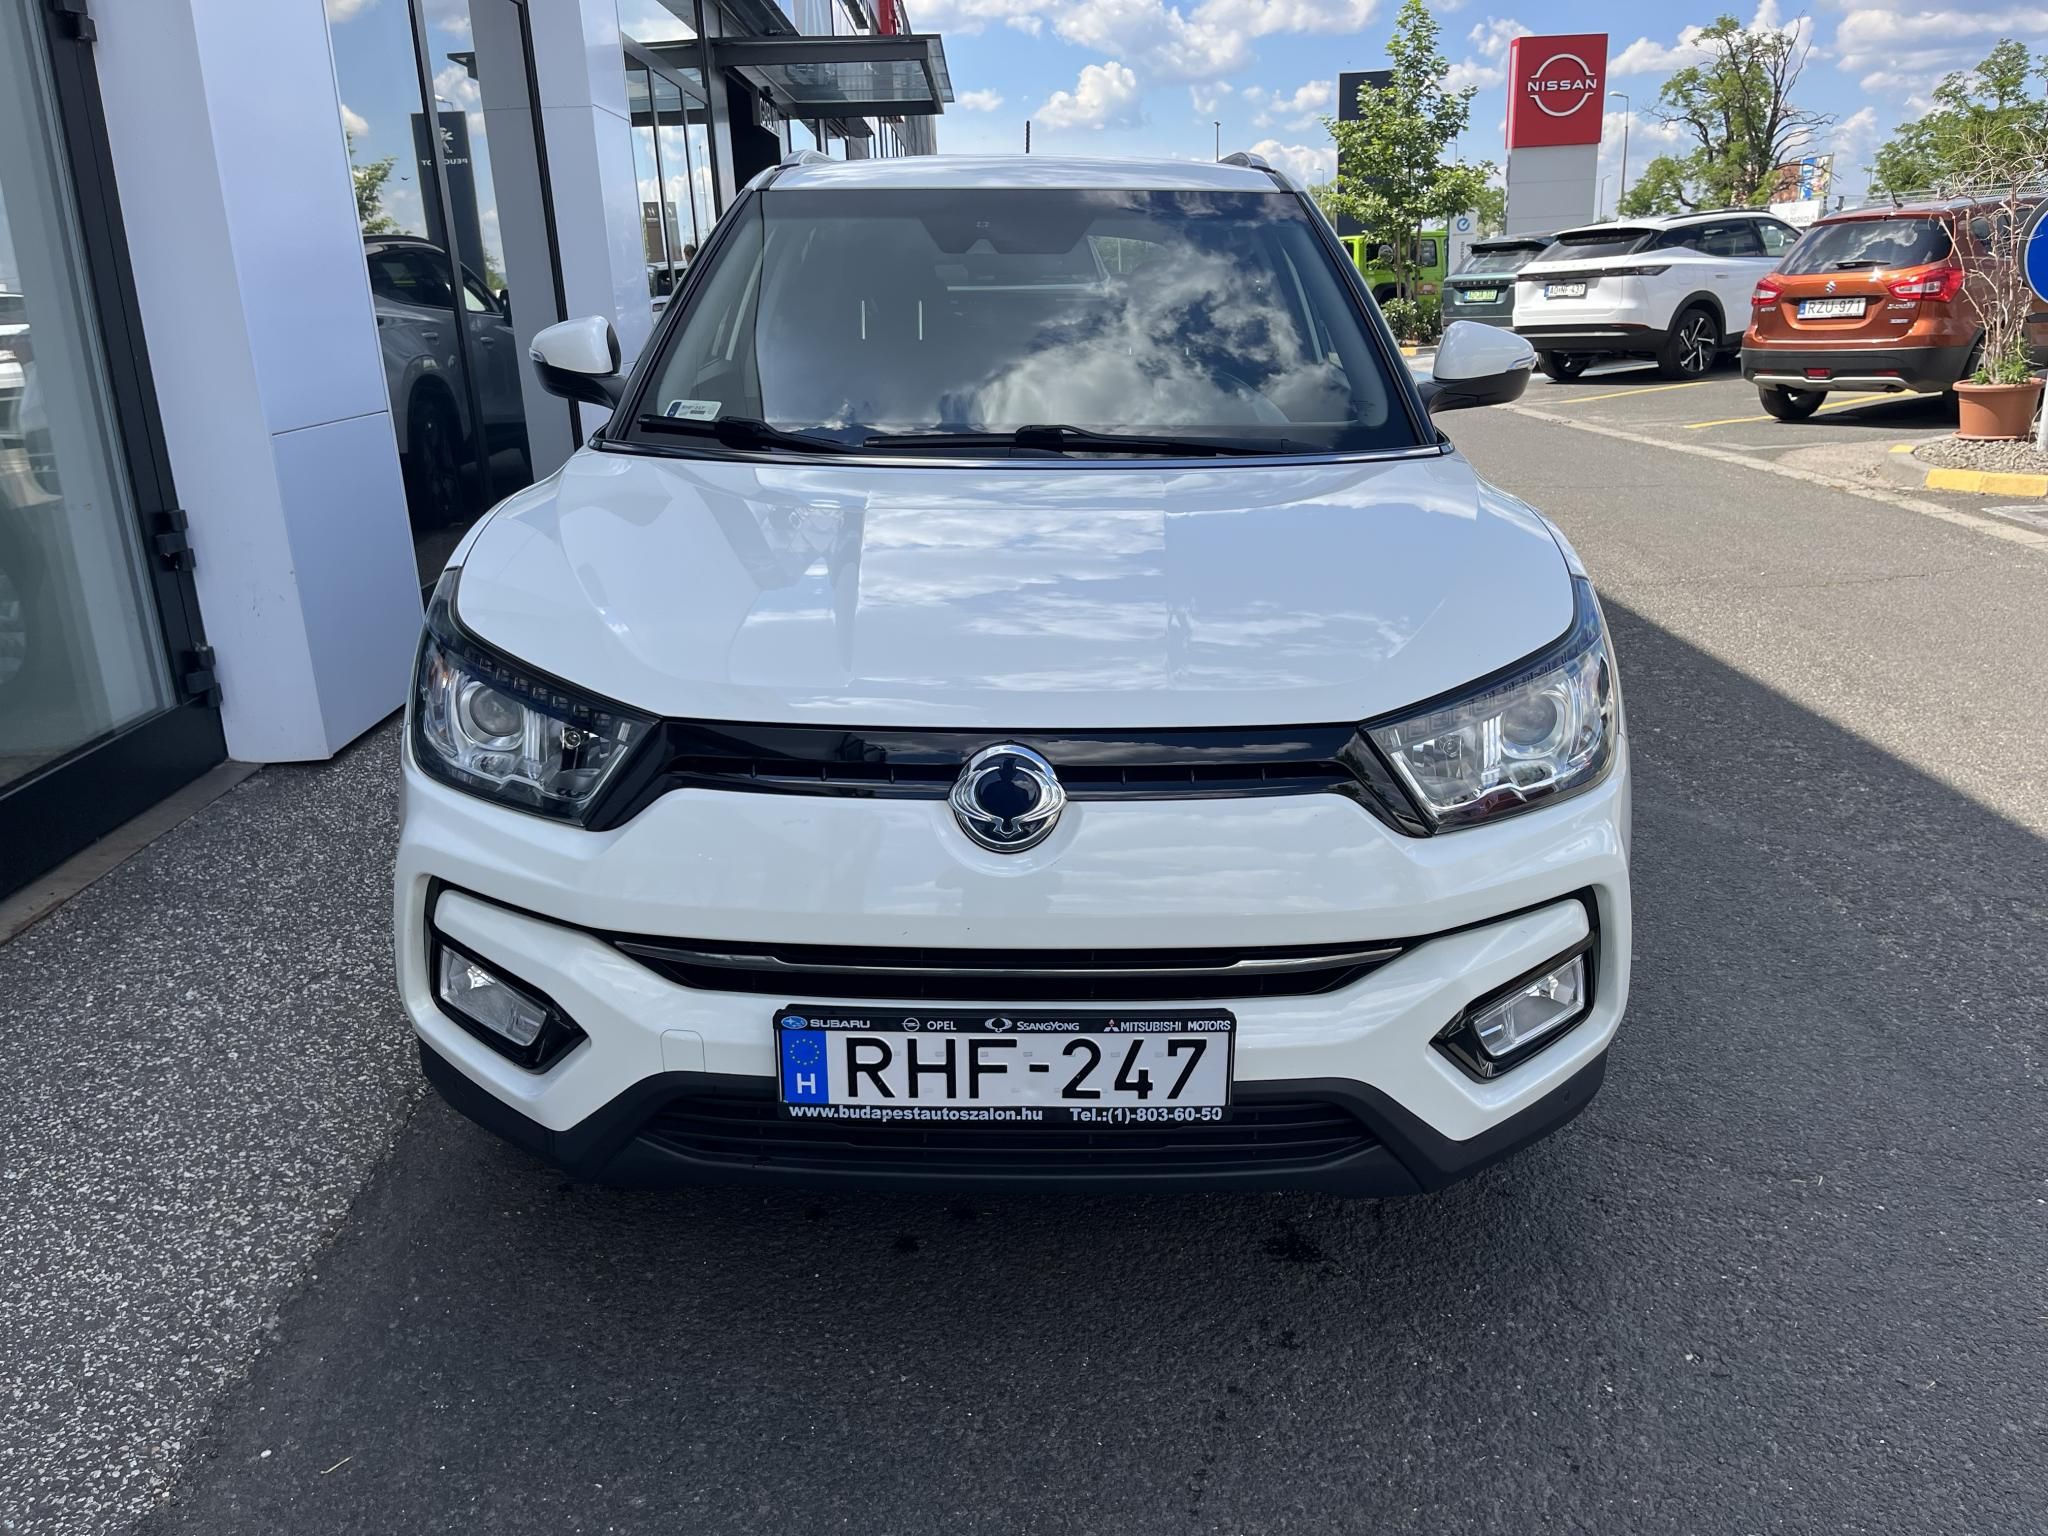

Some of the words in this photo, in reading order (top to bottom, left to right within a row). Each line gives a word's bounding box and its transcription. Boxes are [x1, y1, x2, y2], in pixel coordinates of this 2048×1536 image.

[1527, 79, 1597, 92] NISSAN
[1807, 300, 1861, 314] RZU-971
[810, 1019, 870, 1029] SUBARU
[926, 1020, 957, 1031] OPEL
[1120, 1021, 1182, 1032] MITSUBISHI
[1187, 1020, 1231, 1031] MOTORS
[846, 1037, 1207, 1099] RHF-247
[796, 1072, 816, 1094] H
[789, 1105, 1043, 1122] www.budapestautoszalon.hu
[1070, 1107, 1223, 1124] Tel.:(1)-803-60-50
